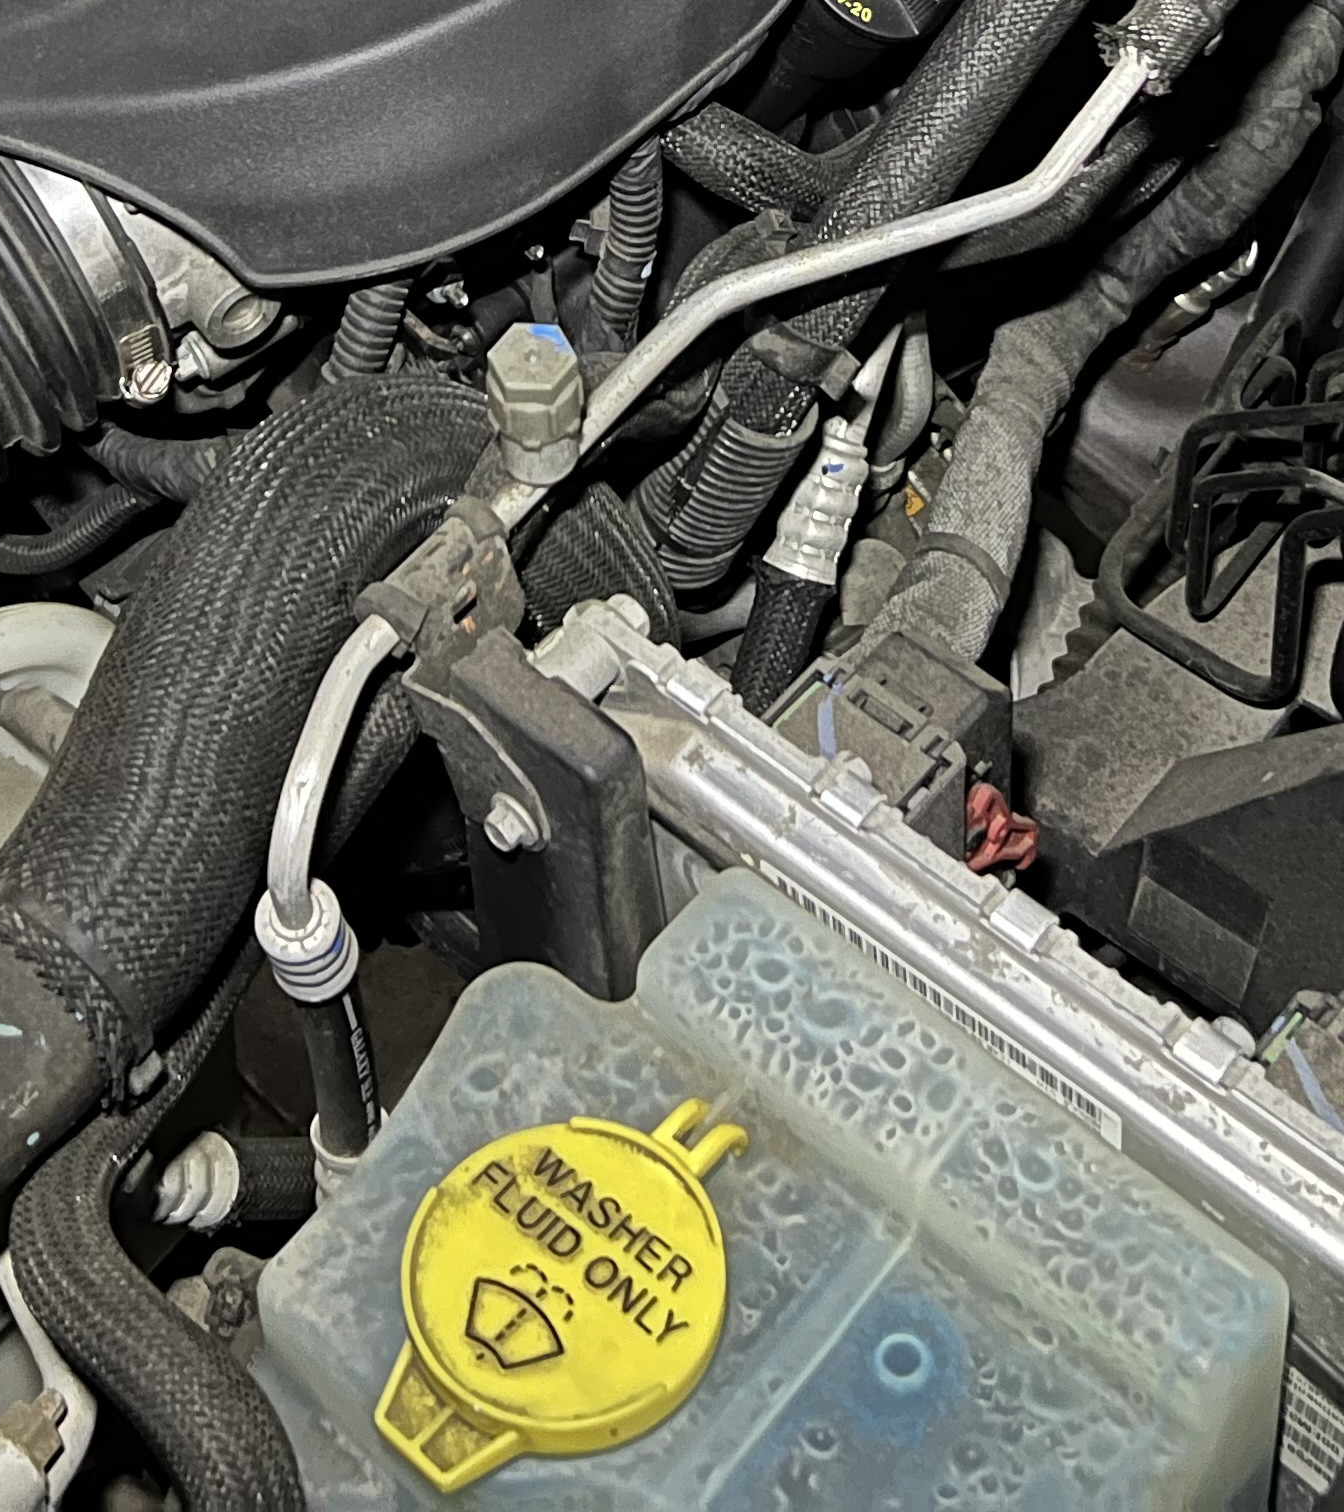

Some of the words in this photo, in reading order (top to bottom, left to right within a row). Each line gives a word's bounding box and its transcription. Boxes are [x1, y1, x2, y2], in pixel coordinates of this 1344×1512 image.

[470, 1160, 582, 1258] FLUID
[583, 1254, 691, 1344] ONLY
[532, 1147, 694, 1293] WASHER
